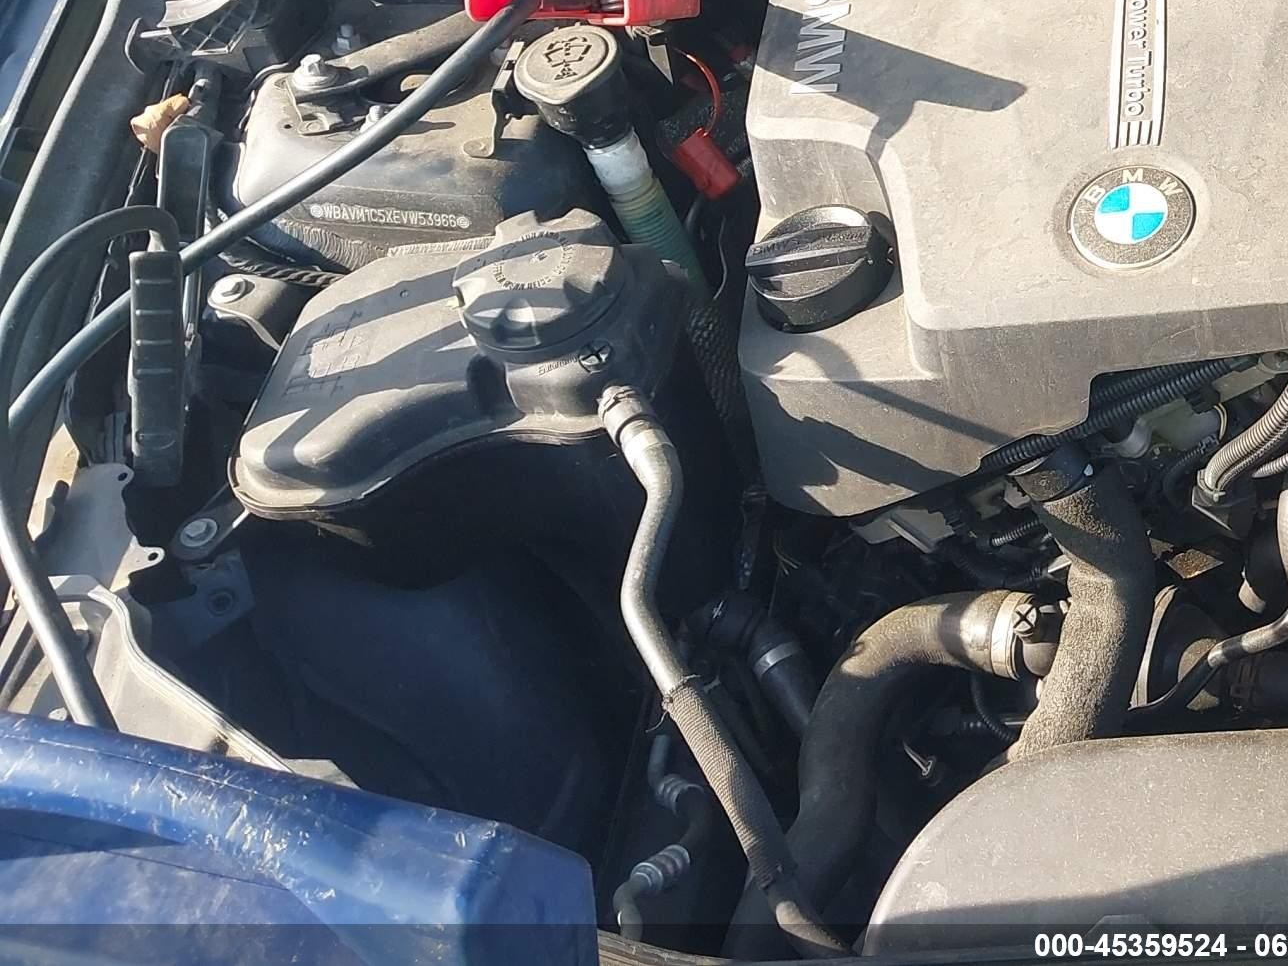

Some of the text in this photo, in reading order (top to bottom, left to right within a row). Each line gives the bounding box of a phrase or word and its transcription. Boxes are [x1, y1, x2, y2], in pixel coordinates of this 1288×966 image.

[1124, 50, 1153, 118] Turbo
[1083, 168, 1184, 204] BMW
[322, 204, 457, 228] WBAVM1C5XEVW53966
